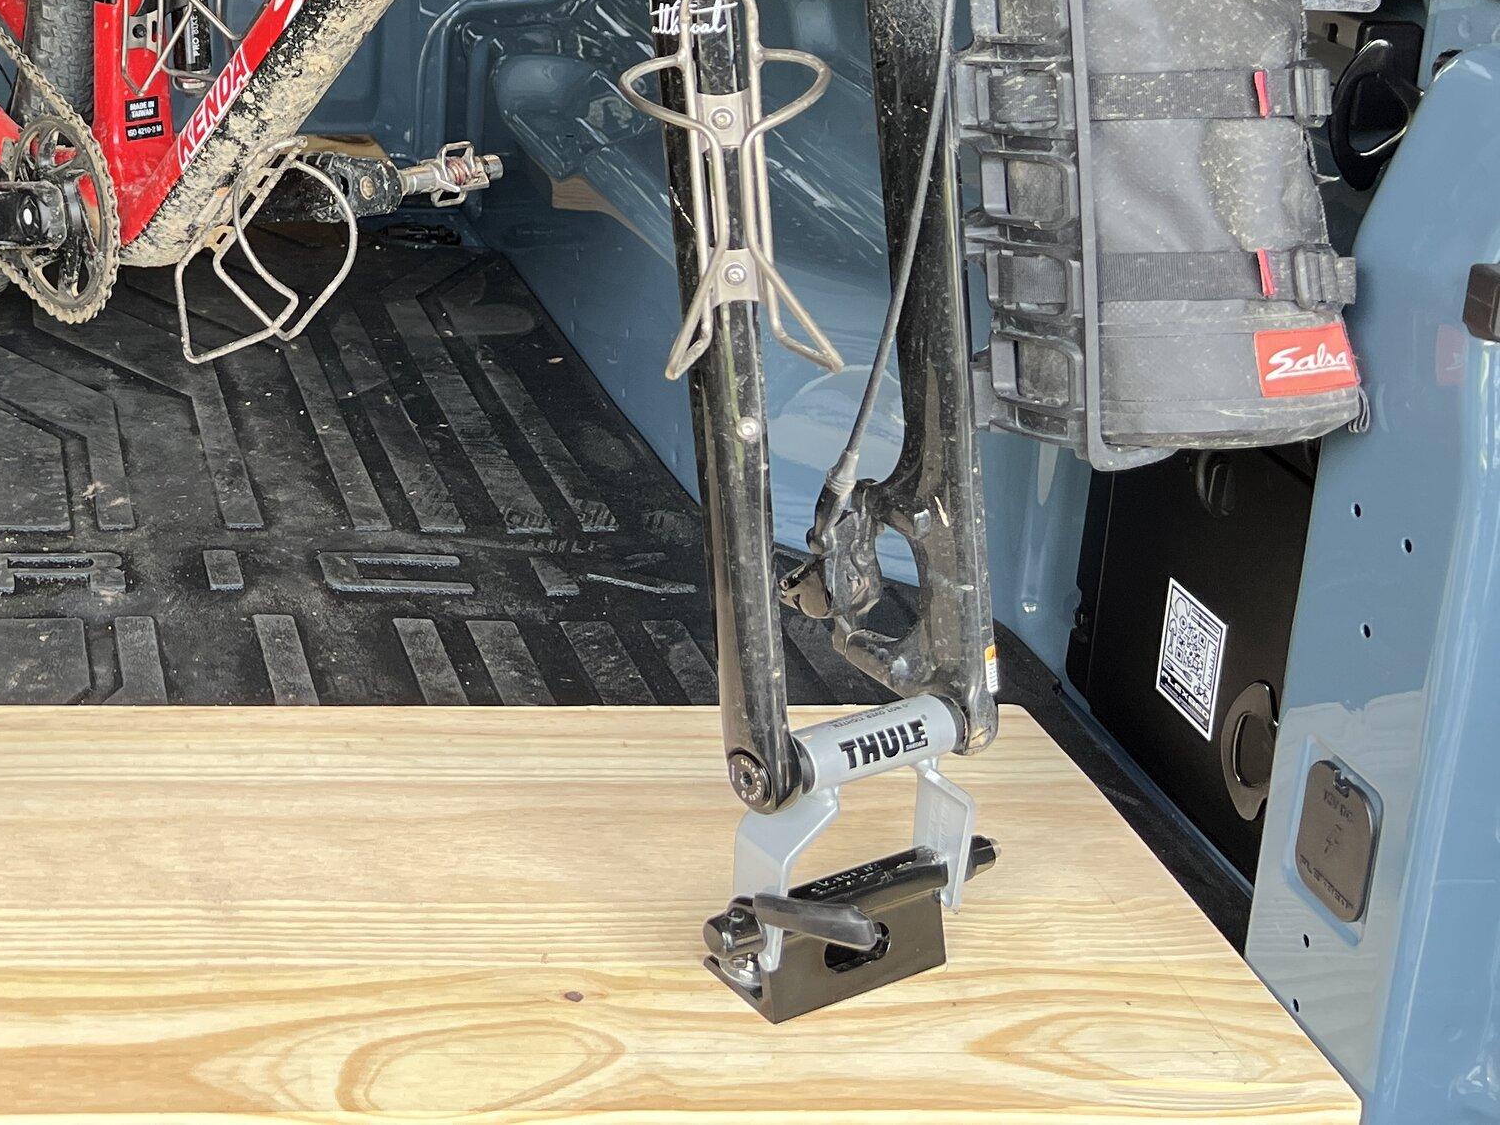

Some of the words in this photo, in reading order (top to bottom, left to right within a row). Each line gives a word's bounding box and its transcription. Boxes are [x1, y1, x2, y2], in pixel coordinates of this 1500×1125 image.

[177, 47, 252, 169] KENDA
[1265, 342, 1352, 381] Salsa
[838, 719, 927, 771] THULE
